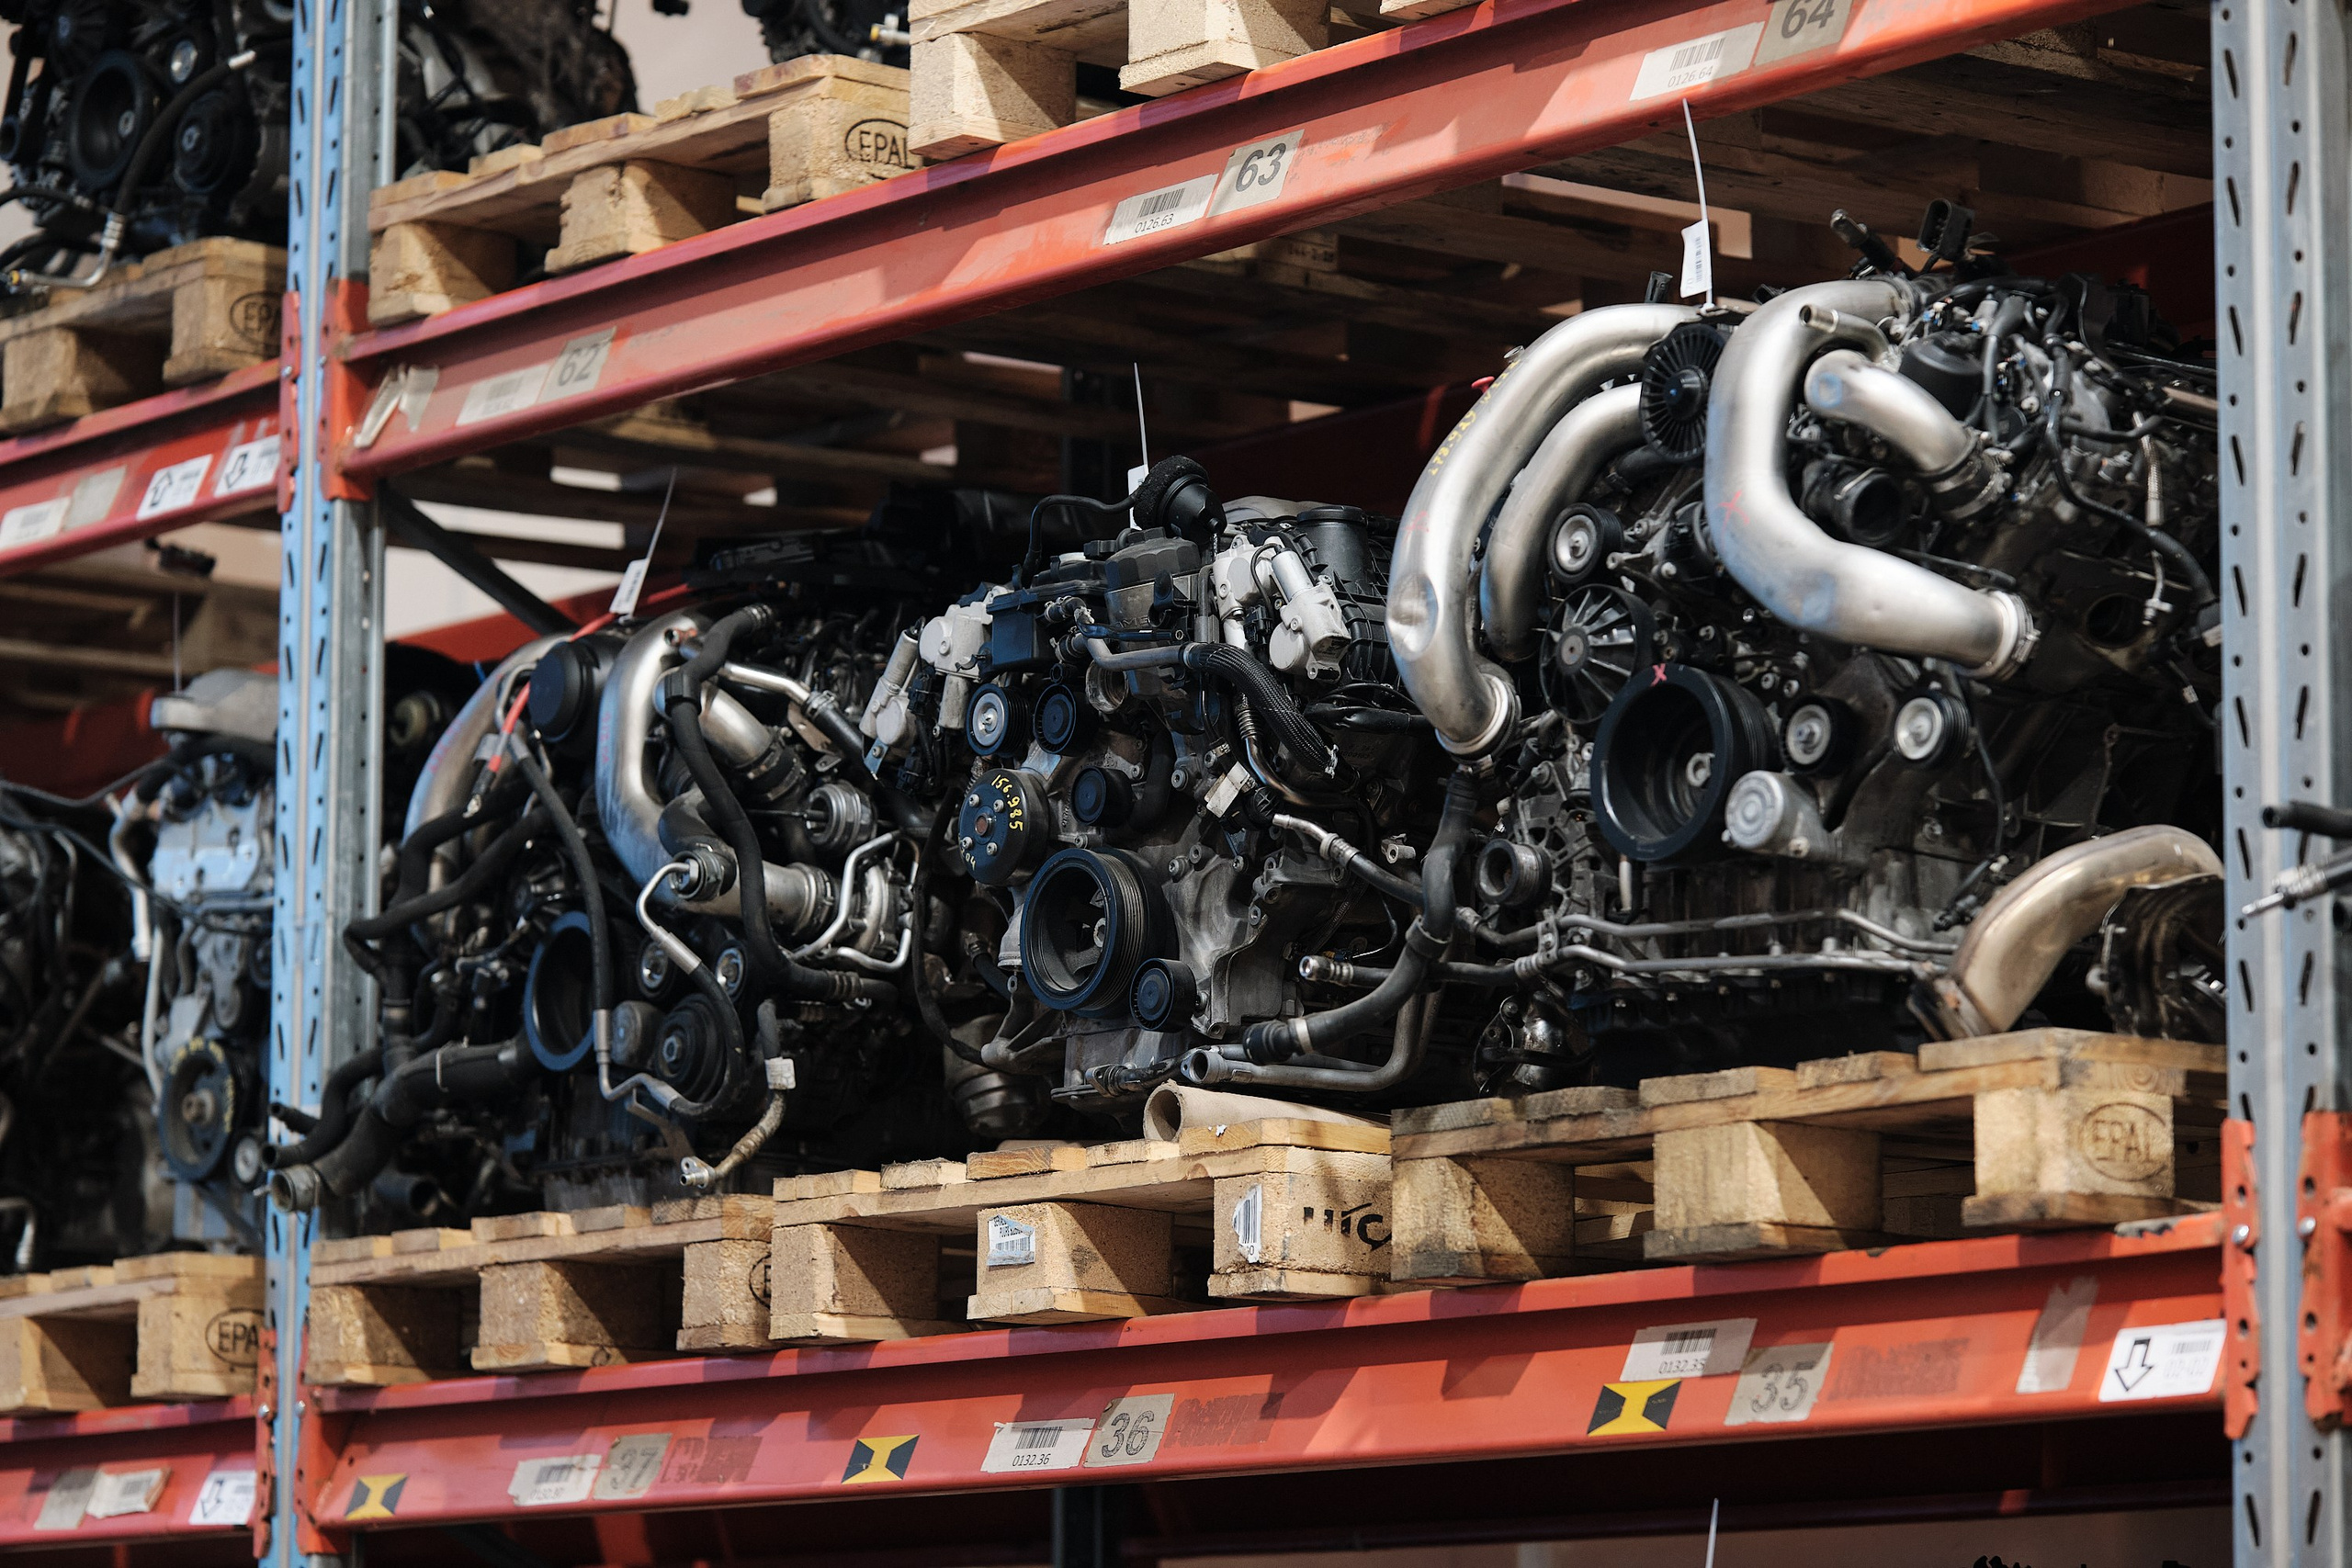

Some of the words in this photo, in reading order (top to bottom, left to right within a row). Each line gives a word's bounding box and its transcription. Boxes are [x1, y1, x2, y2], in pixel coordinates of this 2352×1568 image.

[1781, 0, 1835, 39] 64
[1668, 65, 1713, 88] 0126.64
[860, 130, 915, 170] EPAL
[1236, 142, 1286, 192] 63
[1135, 212, 1175, 234] 0126.63
[557, 344, 602, 388] 62
[990, 773, 1023, 832] 156.985
[218, 1321, 259, 1355] EPA
[1657, 1358, 1707, 1375] 0132.35
[1751, 1360, 1817, 1414] 35
[1102, 1410, 1155, 1459] 36
[608, 1447, 661, 1490] 37
[1012, 1453, 1051, 1468] 0132.36
